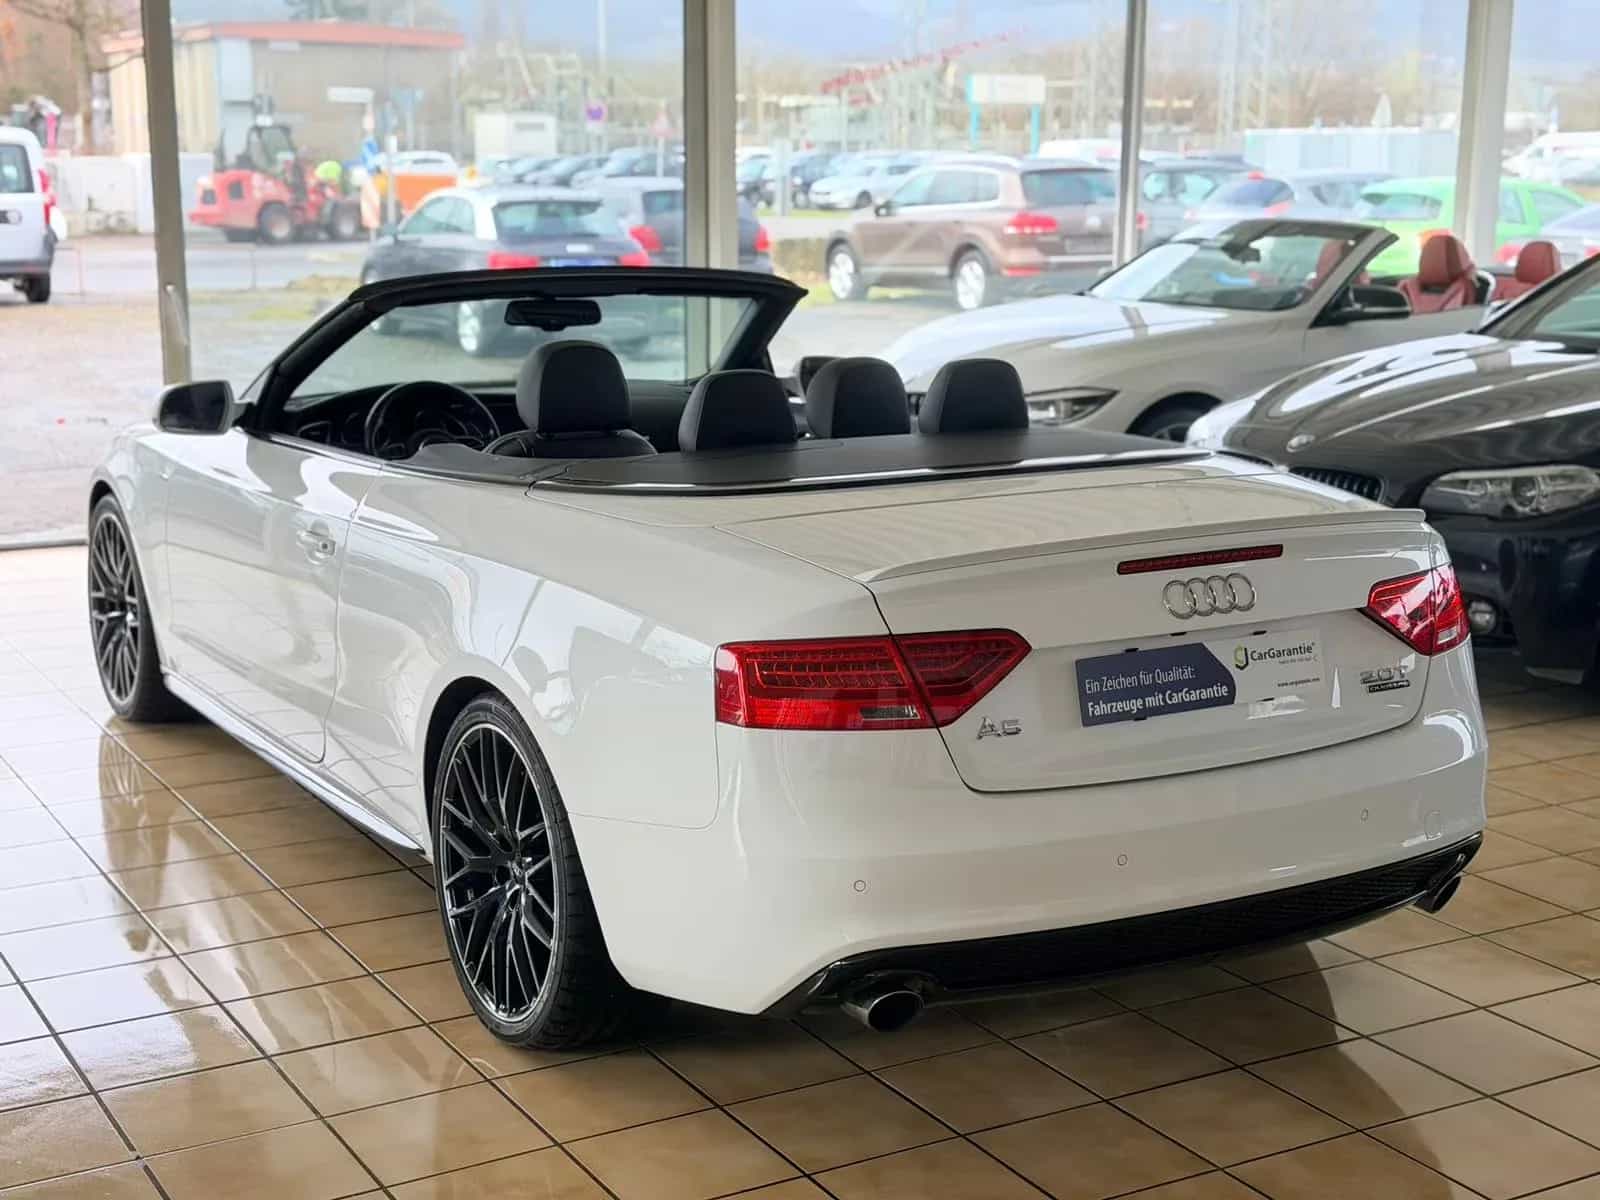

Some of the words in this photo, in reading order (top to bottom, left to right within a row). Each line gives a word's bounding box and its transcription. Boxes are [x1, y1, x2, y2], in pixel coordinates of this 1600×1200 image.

[1085, 679, 1100, 694] Ein
[1102, 674, 1138, 691] Zeichen
[1139, 671, 1153, 686] für
[1154, 665, 1196, 684] Qualität:
[1087, 697, 1143, 717] Fahrzeuge
[1144, 692, 1164, 708] mit
[1165, 683, 1228, 704] CarGarantie
[976, 716, 1022, 740] A5
